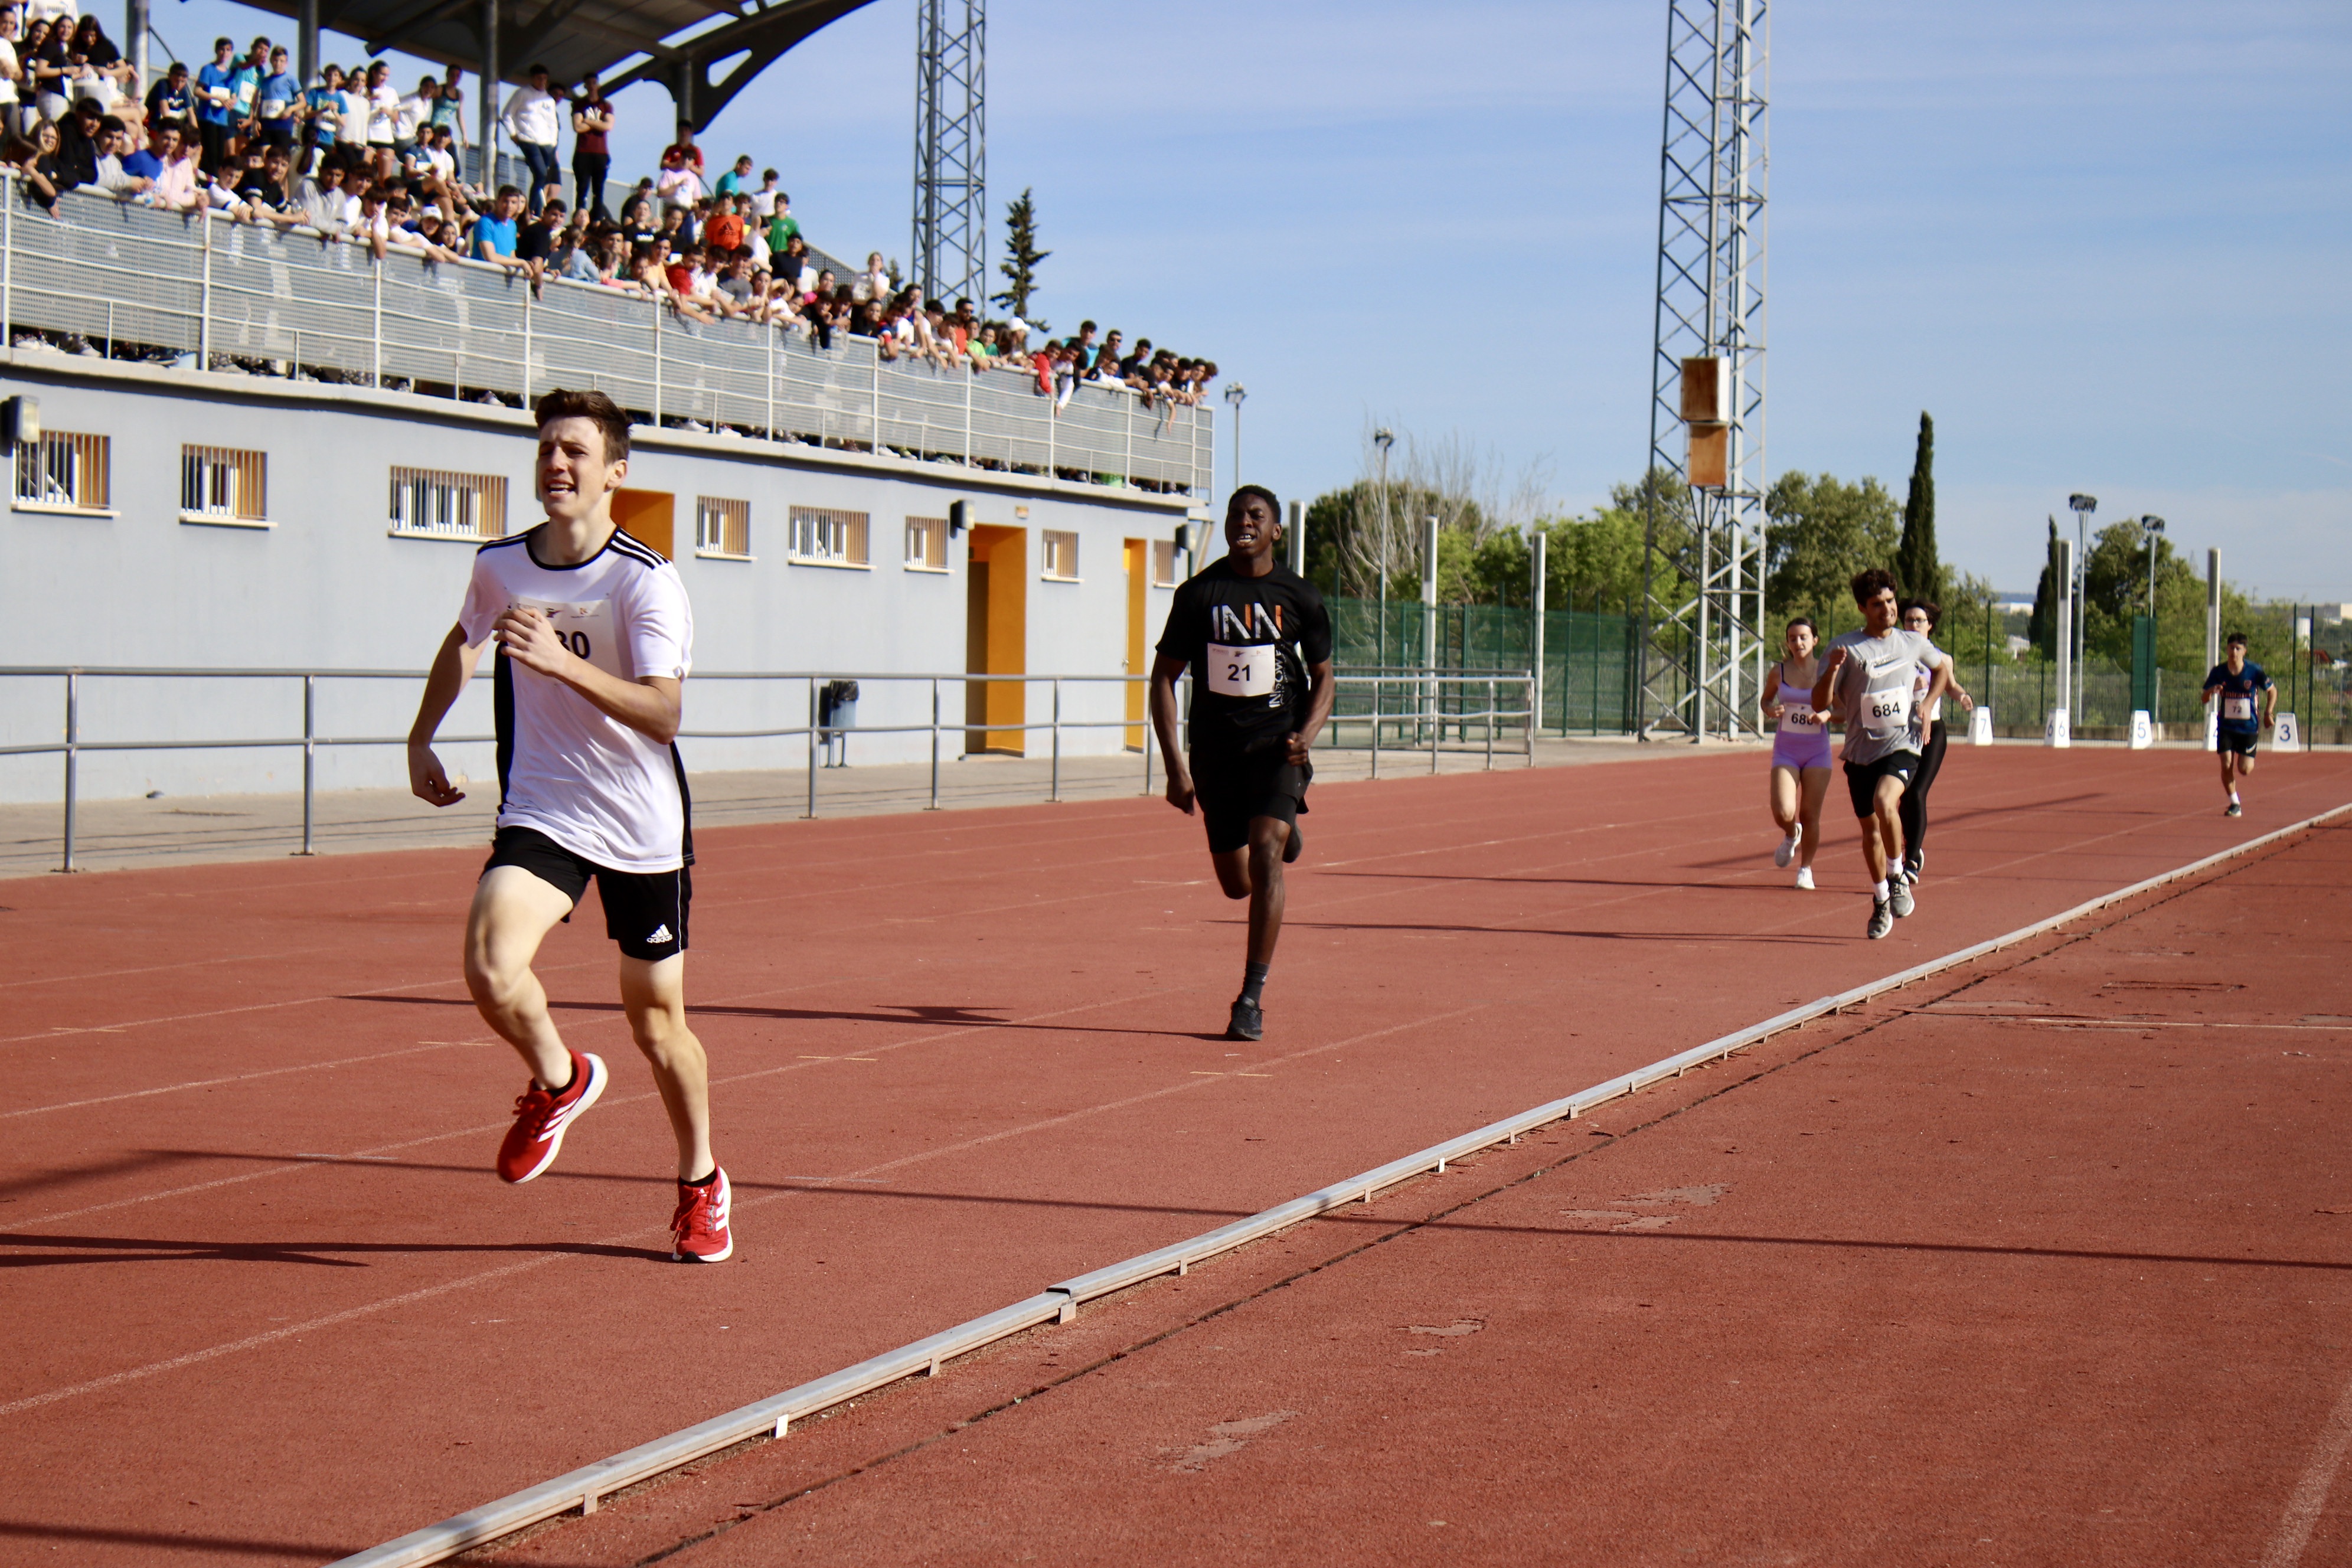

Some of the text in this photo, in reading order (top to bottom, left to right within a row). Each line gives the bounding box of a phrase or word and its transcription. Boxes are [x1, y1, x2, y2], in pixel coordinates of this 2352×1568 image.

[1227, 664, 1250, 681] 21
[1872, 701, 1900, 718] 684
[1981, 717, 1987, 735] 7
[2059, 720, 2066, 737] 6
[2137, 721, 2146, 739] 5
[2279, 724, 2291, 742] 3
[646, 933, 673, 943] adidas
